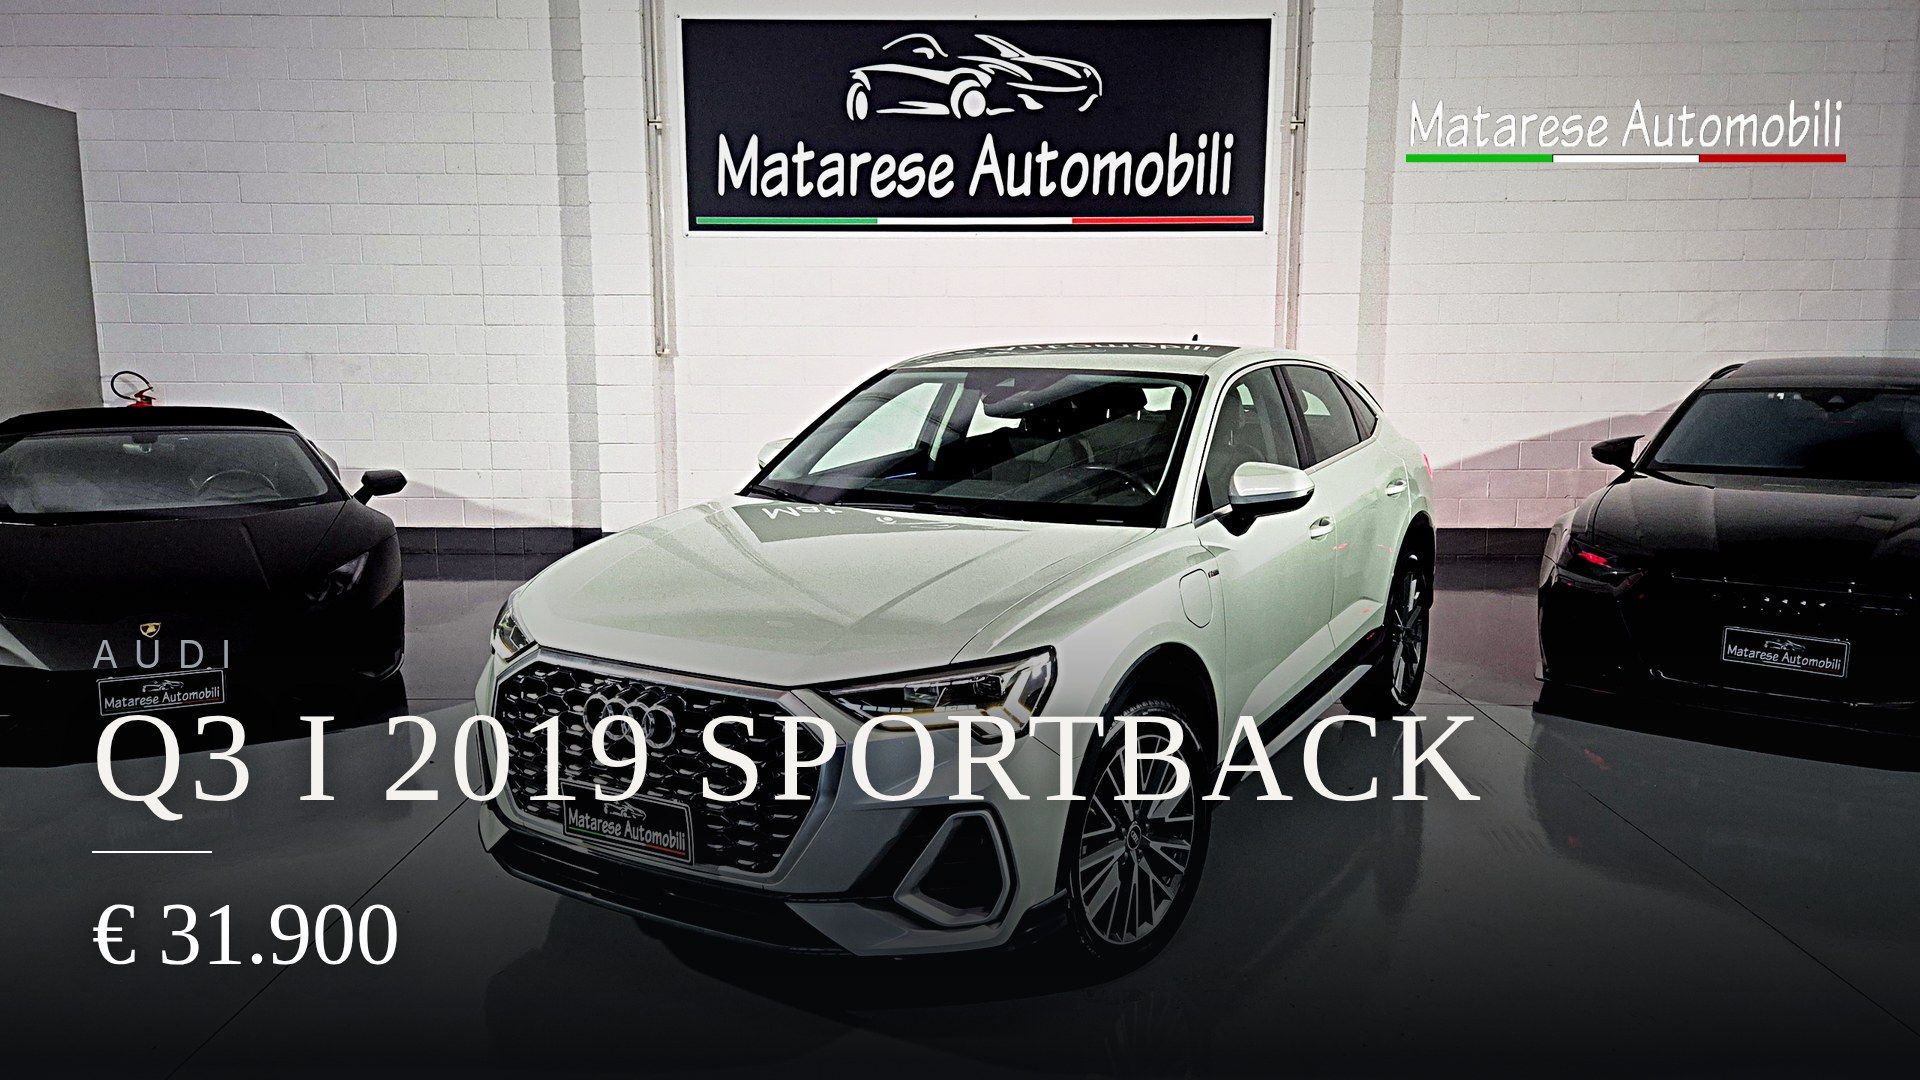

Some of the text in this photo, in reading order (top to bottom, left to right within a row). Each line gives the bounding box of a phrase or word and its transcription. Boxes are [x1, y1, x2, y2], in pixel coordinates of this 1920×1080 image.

[717, 131, 1234, 199] Matarese Automobili
[1726, 644, 1841, 670] Matarese Automobili
[104, 686, 220, 710] Matarese Automobili
[568, 807, 686, 852] Matarese Automobili
